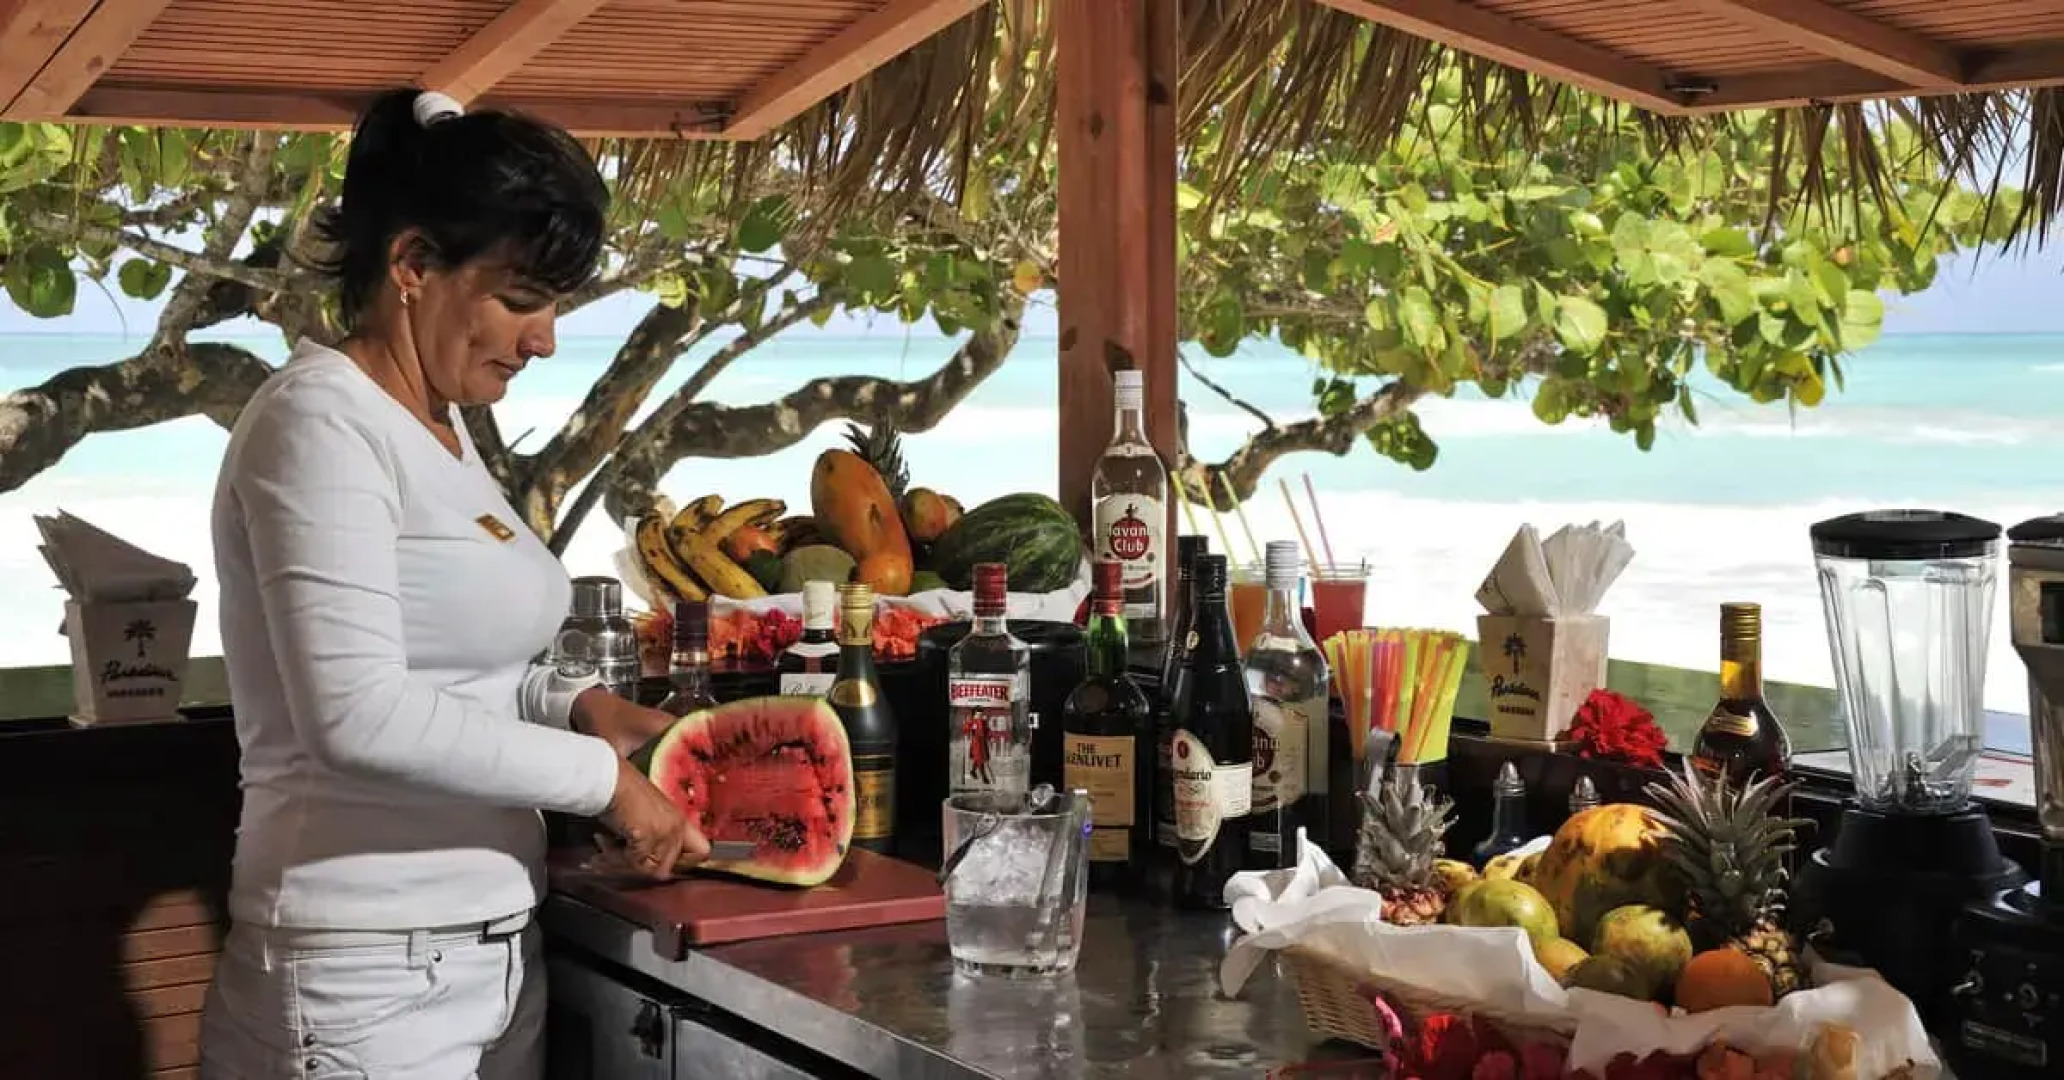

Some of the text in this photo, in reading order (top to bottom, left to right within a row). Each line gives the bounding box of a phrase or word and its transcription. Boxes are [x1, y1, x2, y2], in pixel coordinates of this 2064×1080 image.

[1114, 538, 1144, 553] Club
[951, 685, 1009, 700] BEEFEATER
[1077, 742, 1097, 754] THE
